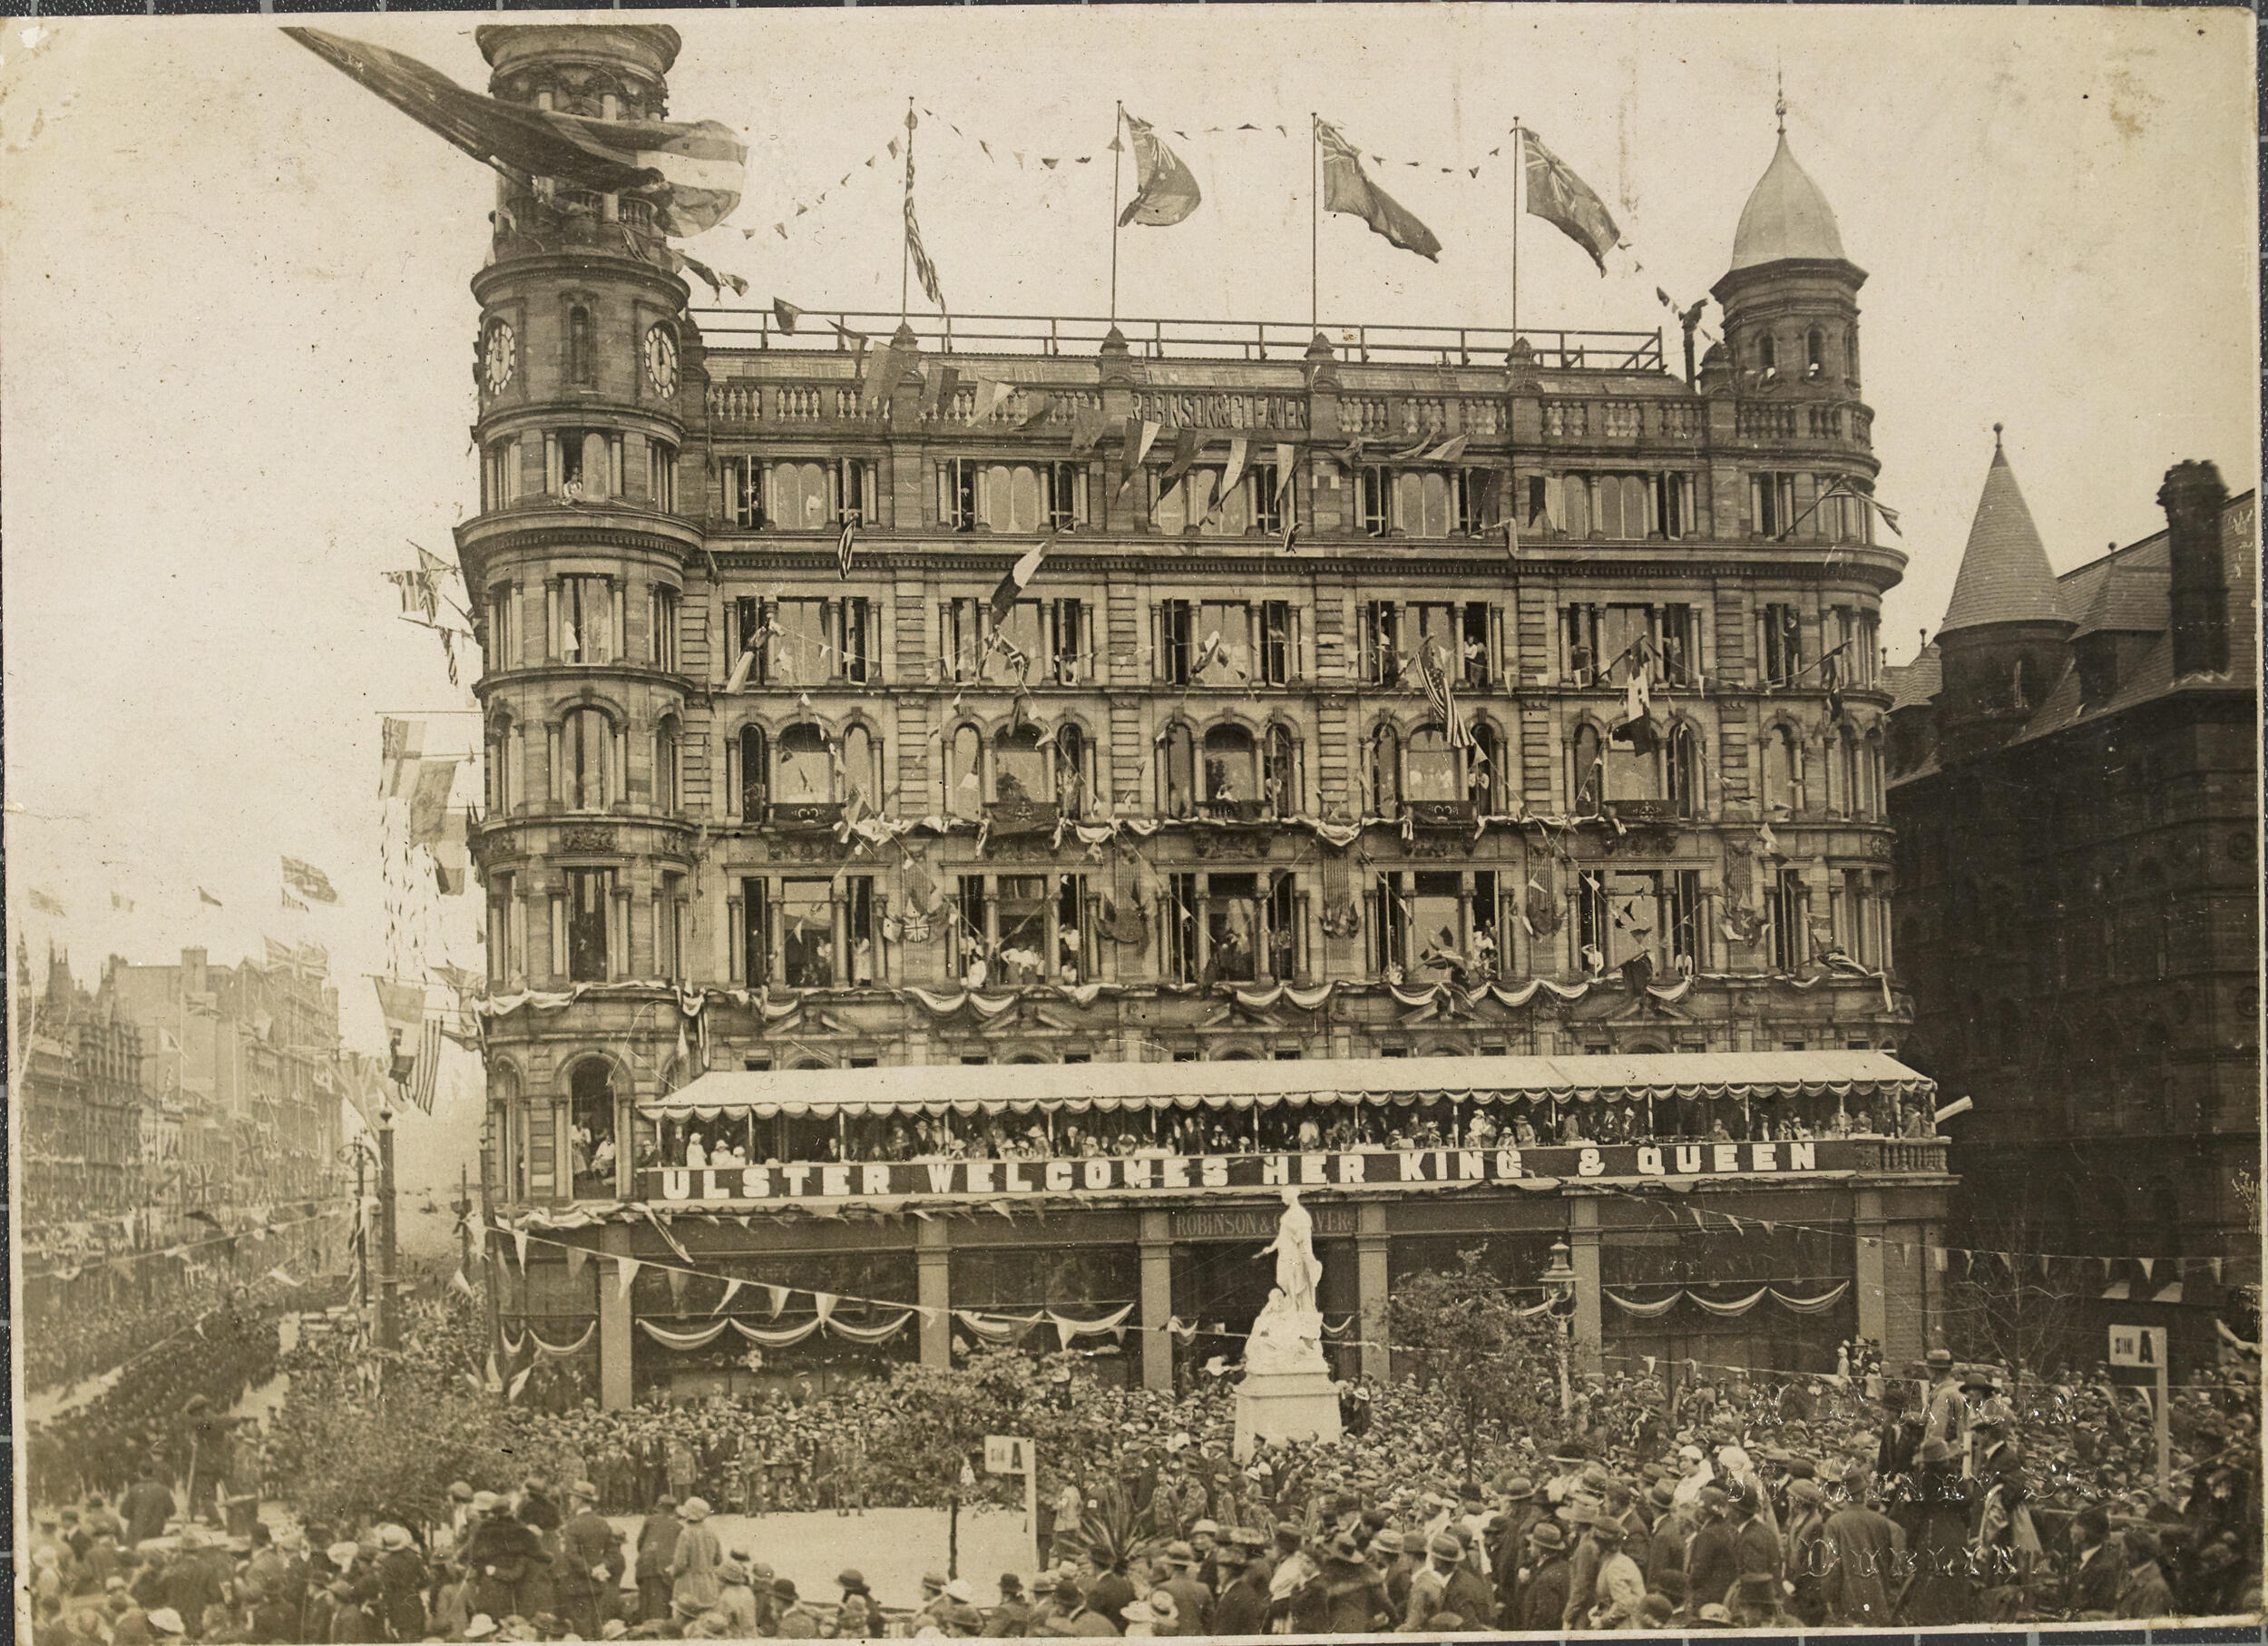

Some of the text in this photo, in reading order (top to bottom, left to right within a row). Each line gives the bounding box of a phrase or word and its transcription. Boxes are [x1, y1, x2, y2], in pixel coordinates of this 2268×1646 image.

[663, 1142, 1815, 1200] ULSTER WELCOMES HER KING & QUEEN
[1178, 1211, 1256, 1235] ROBINSON
[1259, 1216, 1271, 1232] &
[2140, 1330, 2154, 1363] A
[1011, 1442, 1022, 1468] A
